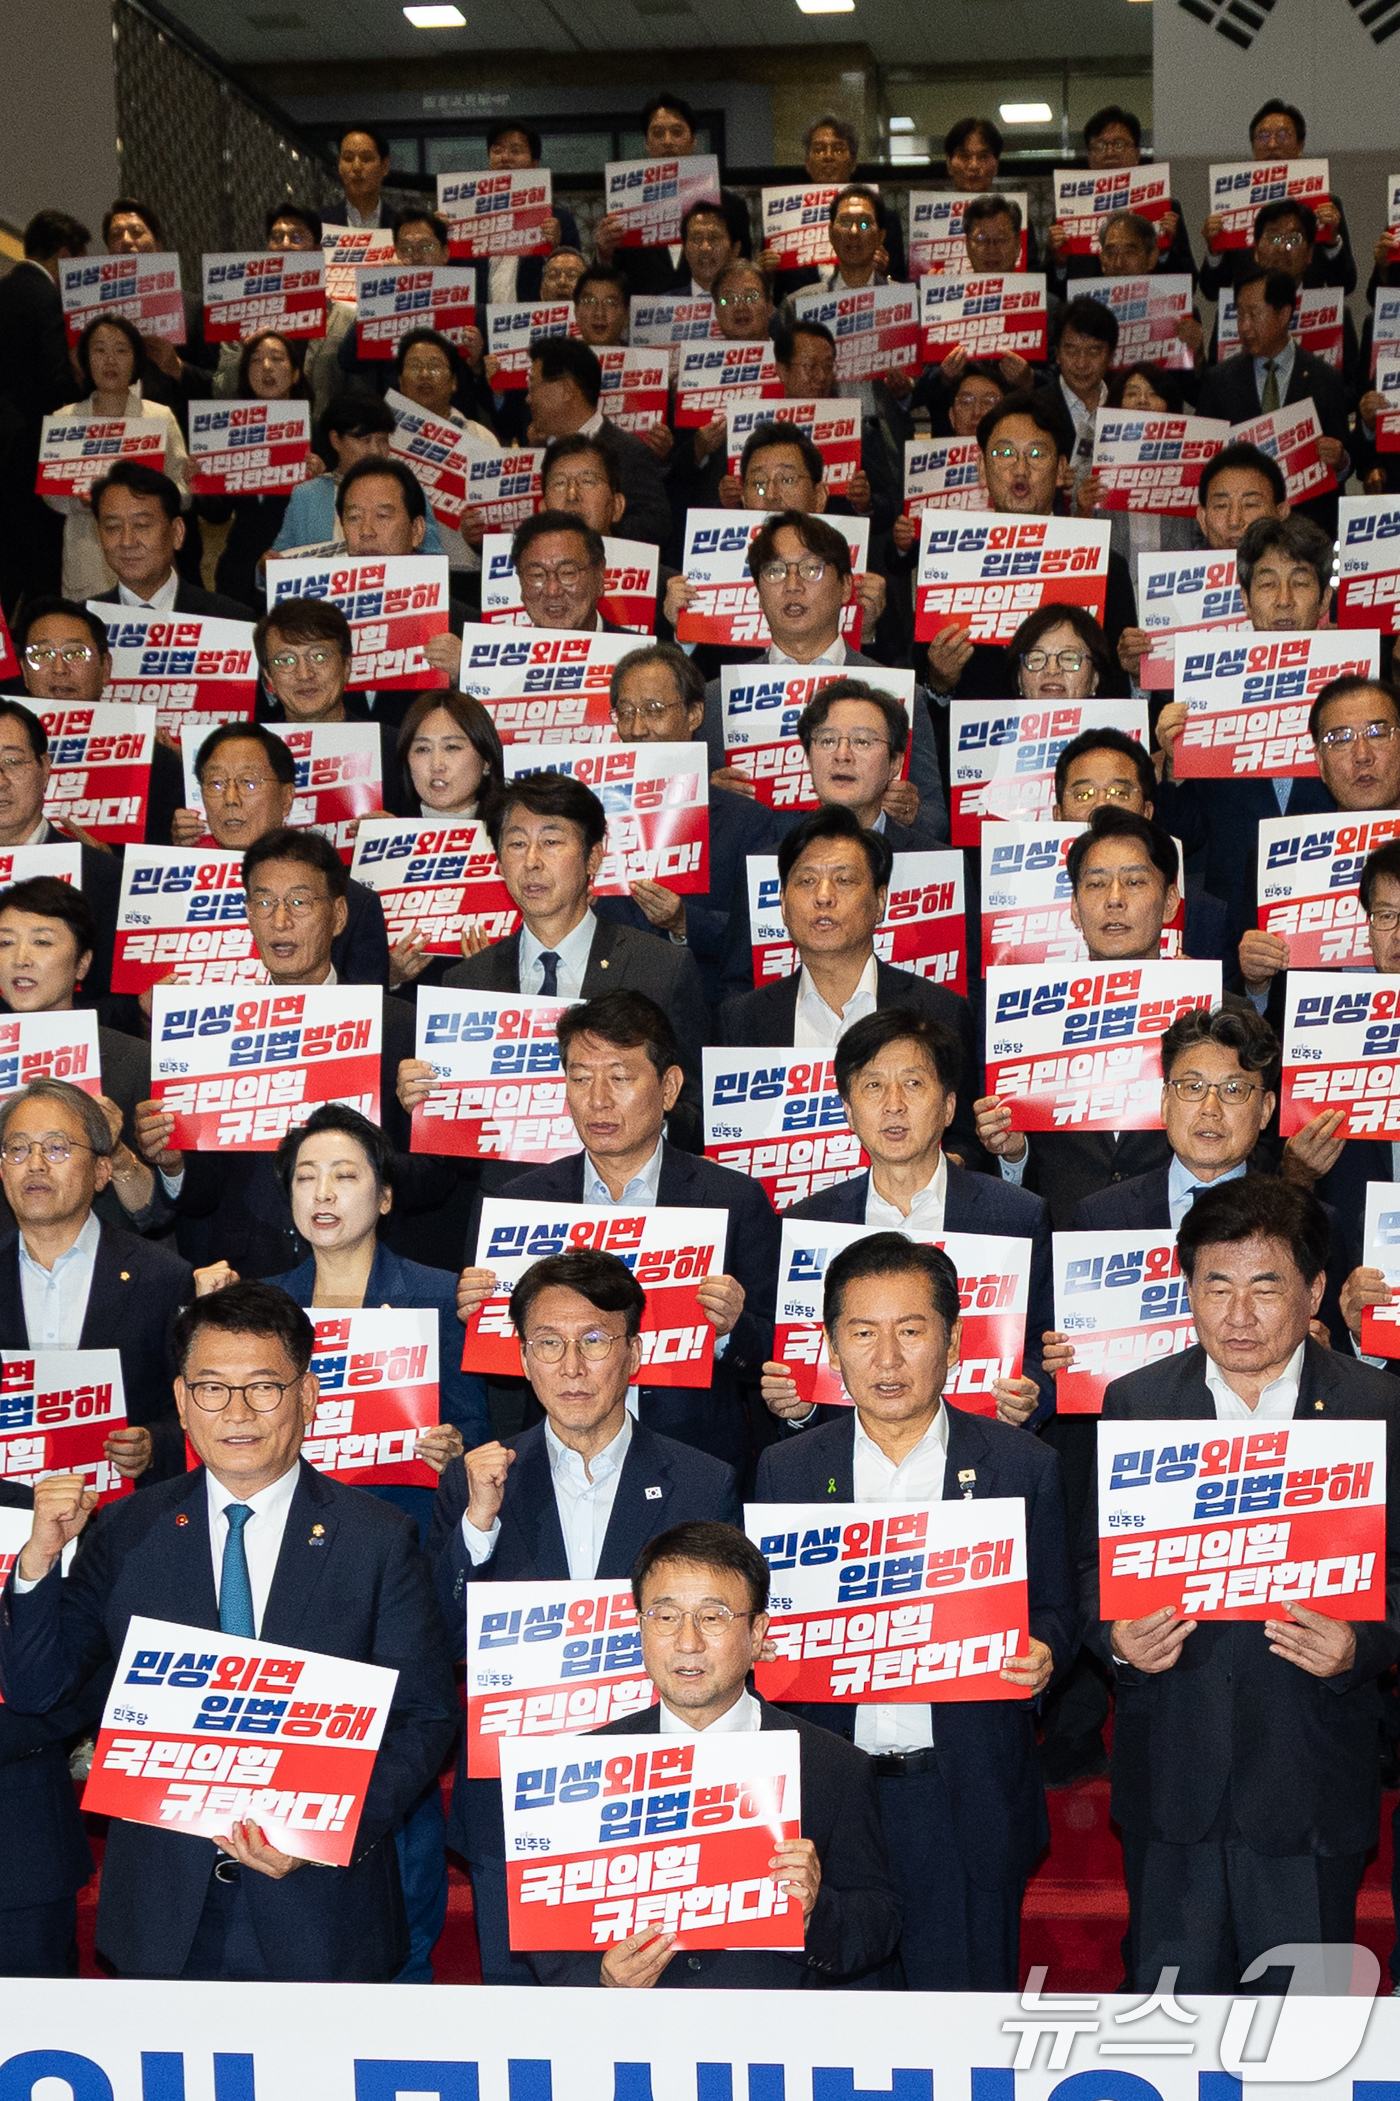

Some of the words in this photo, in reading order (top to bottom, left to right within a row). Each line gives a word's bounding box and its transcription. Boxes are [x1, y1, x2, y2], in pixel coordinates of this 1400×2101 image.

[320, 233, 373, 248] 생외면
[690, 525, 755, 554] 민생
[927, 523, 1047, 554] 민생외면
[1346, 511, 1400, 545] 민생
[601, 566, 650, 594] 방해
[980, 547, 1102, 577] 입법방해
[1147, 560, 1237, 600] 민생외
[923, 583, 1044, 614] 국민의힘
[1345, 574, 1400, 607] 국민
[139, 651, 251, 674] 입법방해
[467, 638, 590, 668] 민생외면
[1182, 638, 1311, 683] 민생외면
[102, 684, 198, 704] 민의힘
[523, 664, 612, 692] 입법방
[37, 709, 95, 738] 외면
[958, 707, 1081, 751] 민생외면
[1182, 705, 1311, 748] 국민의힘
[46, 734, 145, 765] 법방해
[728, 745, 808, 778] 국민의
[41, 795, 139, 828] 탄한다!
[358, 825, 478, 863] 민생외면
[990, 839, 1066, 875] 민생
[1266, 817, 1400, 868] 민생외면
[403, 850, 501, 883] 입법방
[594, 842, 702, 886] 탄한다!
[186, 893, 248, 922] 입법
[378, 887, 466, 919] 민의힘
[885, 883, 955, 920] 방해
[1265, 886, 1292, 897] 민주당
[124, 913, 152, 925] 민주당
[1265, 894, 1364, 935] 국민의
[122, 929, 254, 963] 국민의힘
[757, 928, 785, 939] 민주당
[995, 969, 1141, 1022] 민생외면
[1294, 990, 1400, 1027] 민생외
[161, 994, 305, 1042] 민생외면
[228, 1020, 372, 1066] 입법방해
[490, 1042, 562, 1074] 입법
[993, 1042, 1023, 1054] 민주당
[1291, 1048, 1322, 1060] 민주당
[159, 1062, 189, 1073] 민주당
[994, 1046, 1143, 1097] 국민의힘
[1291, 1065, 1400, 1102] 국민의
[160, 1069, 306, 1116] 국민의힘
[423, 1083, 567, 1120] 국민의힘
[1052, 1078, 1164, 1125] 규탄한
[782, 1094, 845, 1131] 입법
[478, 1117, 578, 1152] 규탄한
[712, 1126, 743, 1137] 민주당
[715, 1134, 862, 1180] 국민의힘
[486, 1218, 646, 1258] 민생외면
[626, 1248, 713, 1283] 방해
[1065, 1244, 1179, 1294] 민생외
[783, 1304, 816, 1318] 민주당
[1064, 1316, 1097, 1328] 민주당
[311, 1344, 428, 1392] 법방해
[1067, 1327, 1190, 1375] 국민의
[0, 1383, 111, 1430] 법방해
[302, 1426, 431, 1473] 탄한다!
[1109, 1430, 1289, 1490] 민생외면
[1193, 1462, 1373, 1519] 입법방해
[1109, 1514, 1145, 1527] 민주당
[759, 1510, 928, 1573] 민생외면
[1111, 1522, 1291, 1579] 국민의힘
[838, 1541, 1015, 1602] 입법방해
[1181, 1552, 1375, 1613] 규탄한다!
[767, 1604, 933, 1661] 국민의힘
[123, 1650, 305, 1695] 민생외면
[560, 1631, 644, 1677] 입법
[829, 1635, 1021, 1695] 규탄한다!
[478, 1673, 513, 1687] 민주당
[112, 1707, 149, 1727] 민주당
[192, 1695, 377, 1742] 입법방해
[480, 1679, 653, 1737] 국민의힘
[101, 1738, 283, 1785] 국민의힘
[513, 1743, 694, 1811] 민생외면
[159, 1782, 355, 1833] 규탄한다!
[513, 1837, 551, 1852] 민주당
[519, 1843, 700, 1906] 국민의힘
[590, 1876, 789, 1943] 규탄한다!
